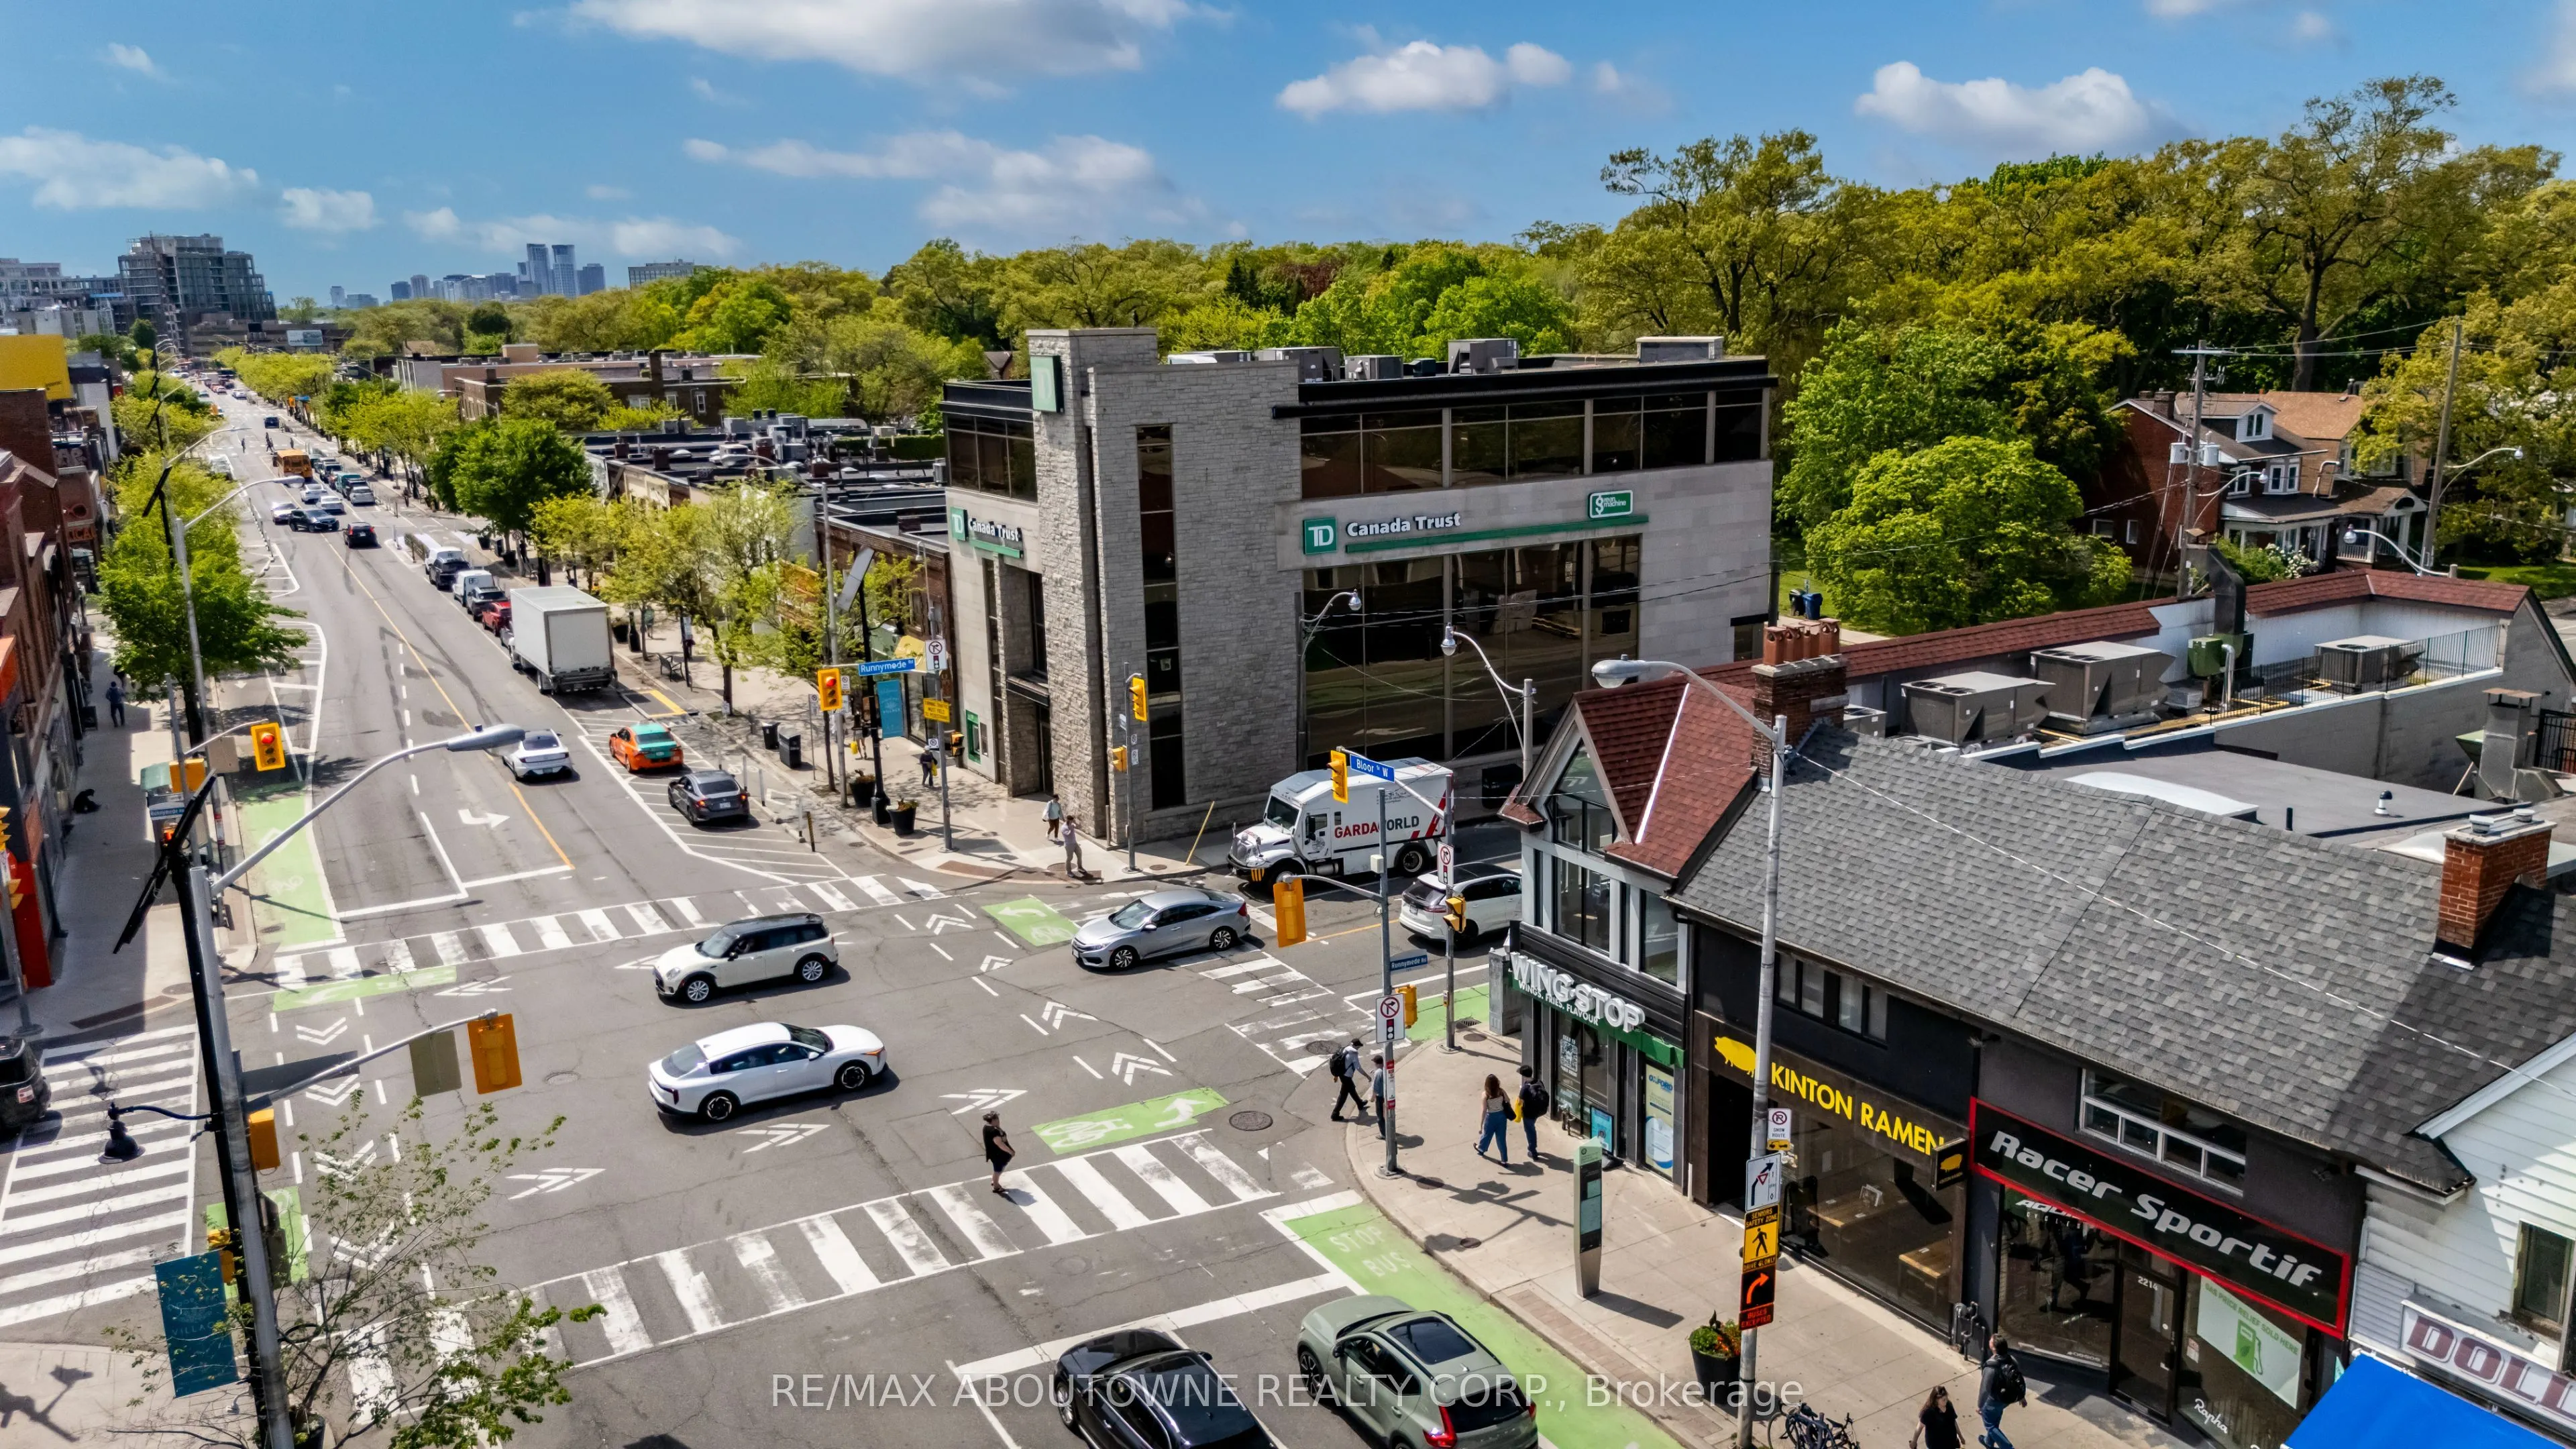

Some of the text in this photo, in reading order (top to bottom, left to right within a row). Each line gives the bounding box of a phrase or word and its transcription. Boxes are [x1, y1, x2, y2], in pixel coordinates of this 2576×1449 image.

[952, 514, 1019, 541] TD Canada Trust
[1308, 512, 1461, 547] TD Canada Trust
[861, 661, 907, 674] Runnymede
[1356, 759, 1374, 773] Bloor
[1382, 767, 1389, 777] W
[1334, 816, 1419, 839] GARDAORLD
[1391, 957, 1421, 969] Runnymede
[1771, 1062, 1945, 1155] KINTON RAMEN
[1752, 1208, 1773, 1219] SENIORS
[1990, 1130, 2322, 1287] Racer Sportif
[1746, 1214, 1778, 1228] SAFETY ZONE
[1329, 1226, 1385, 1252] STOP
[1362, 1252, 1411, 1277] BUS
[1743, 1262, 1757, 1271] DRIVE
[2138, 1276, 2158, 1291] 2214
[2204, 1283, 2299, 1356] GAS PRICE RELIEF SOLD HERE
[2194, 1398, 2229, 1434] Rapha
